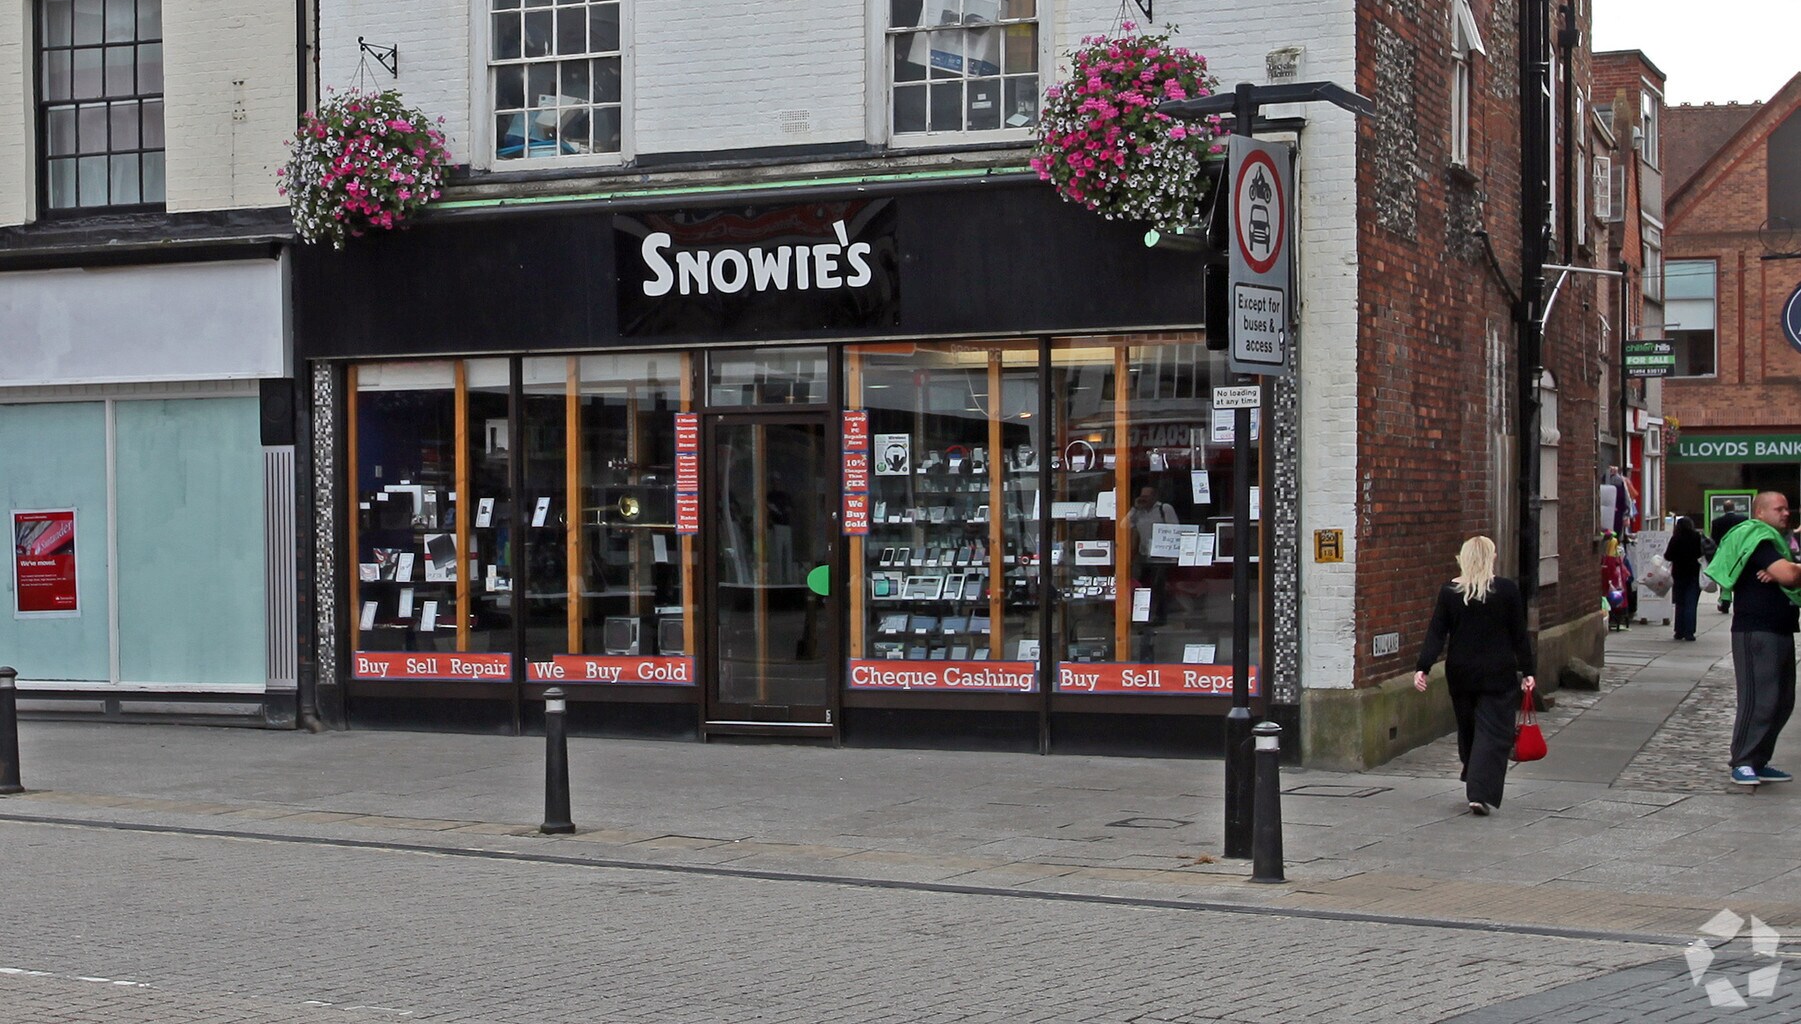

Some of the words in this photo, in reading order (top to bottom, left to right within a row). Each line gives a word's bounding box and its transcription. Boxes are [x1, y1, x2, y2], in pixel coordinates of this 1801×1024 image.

[641, 219, 872, 297] SNOWIE'S
[1238, 293, 1266, 314] Except
[1268, 297, 1280, 313] for
[1243, 315, 1267, 332] buses
[1269, 318, 1275, 333] &
[1245, 339, 1273, 354] access
[1626, 356, 1646, 365] FOR
[1648, 356, 1669, 364] SALE
[1230, 389, 1257, 397] loading
[1680, 442, 1749, 456] LLOYDS
[1755, 441, 1801, 456] BANK
[846, 459, 866, 467] 10%
[847, 500, 863, 508] We
[846, 510, 866, 519] Buy
[844, 520, 867, 528] Gold
[358, 658, 390, 678] Buy
[406, 658, 438, 674] Sell
[450, 658, 507, 678] Repair
[534, 661, 565, 678] We
[585, 661, 622, 683] Buy
[637, 661, 687, 680] Gold
[852, 666, 937, 690] Cheque
[943, 667, 1033, 692] Cashing
[1060, 669, 1099, 691] Buy
[1121, 669, 1160, 688] Sell
[1183, 670, 1255, 693] Repar
